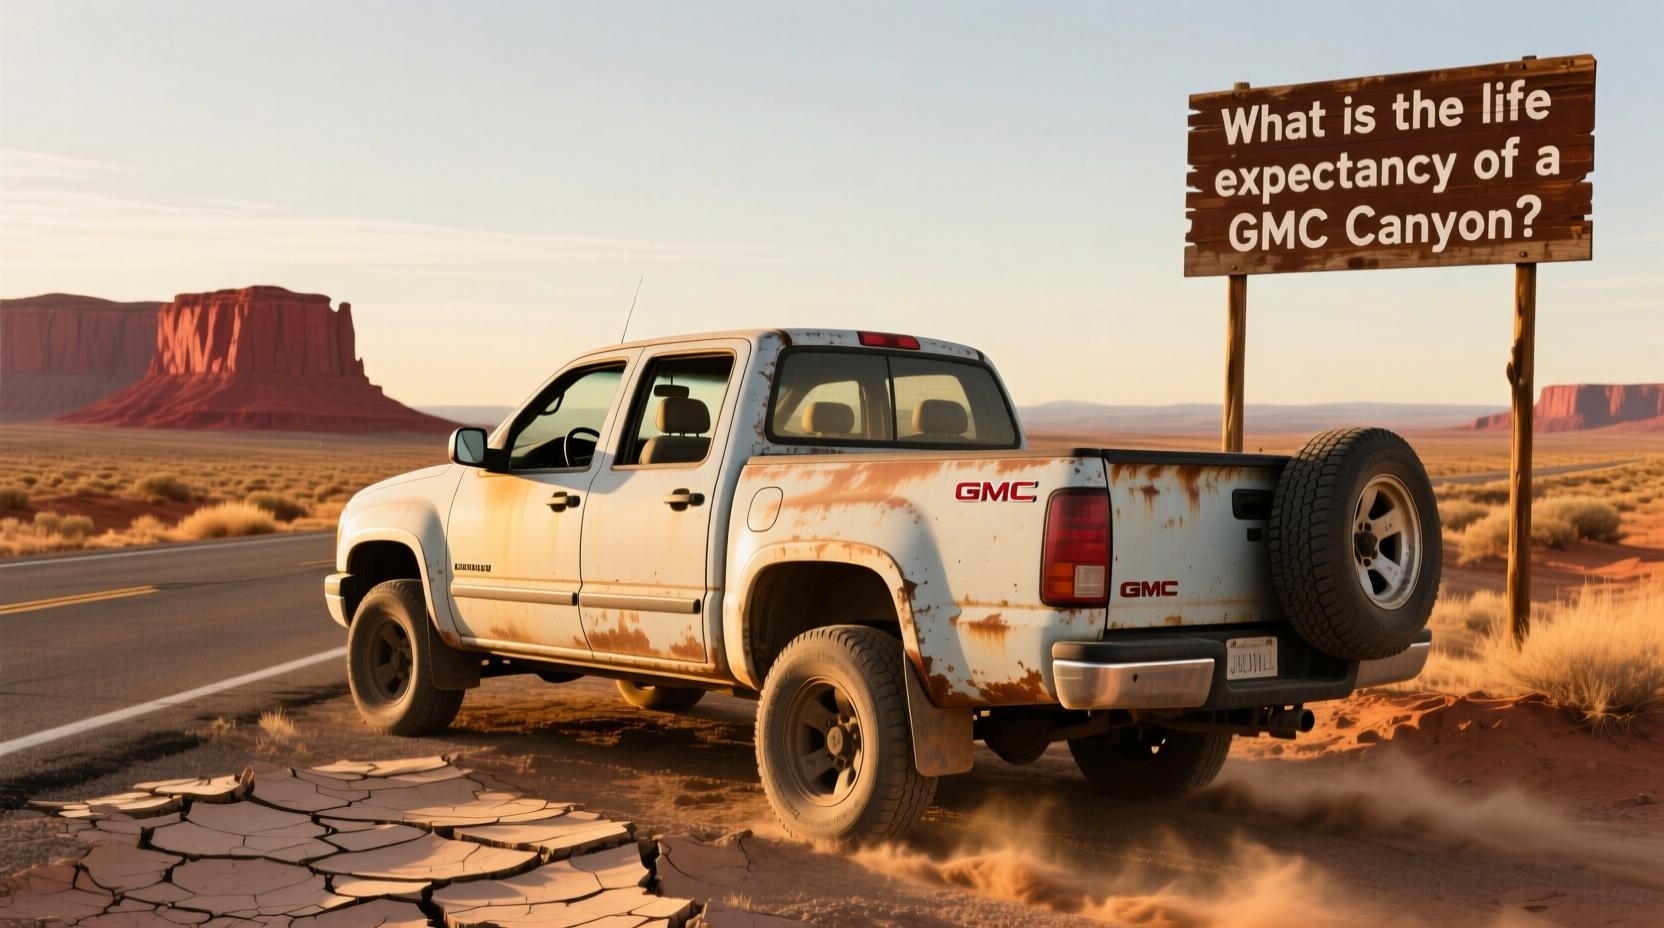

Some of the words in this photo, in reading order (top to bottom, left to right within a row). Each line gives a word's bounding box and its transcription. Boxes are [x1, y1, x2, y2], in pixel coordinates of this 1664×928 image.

[1221, 100, 1326, 145] What
[1343, 96, 1376, 135] is
[1392, 89, 1464, 131] the
[1482, 79, 1551, 124] life
[1215, 152, 1457, 205] expectancy
[1474, 136, 1520, 180] of
[1535, 145, 1560, 176] a
[1229, 208, 1328, 252] GMC
[1345, 194, 1542, 253] Canyon?
[955, 481, 1038, 502] GMC
[1120, 581, 1178, 597] GMC
